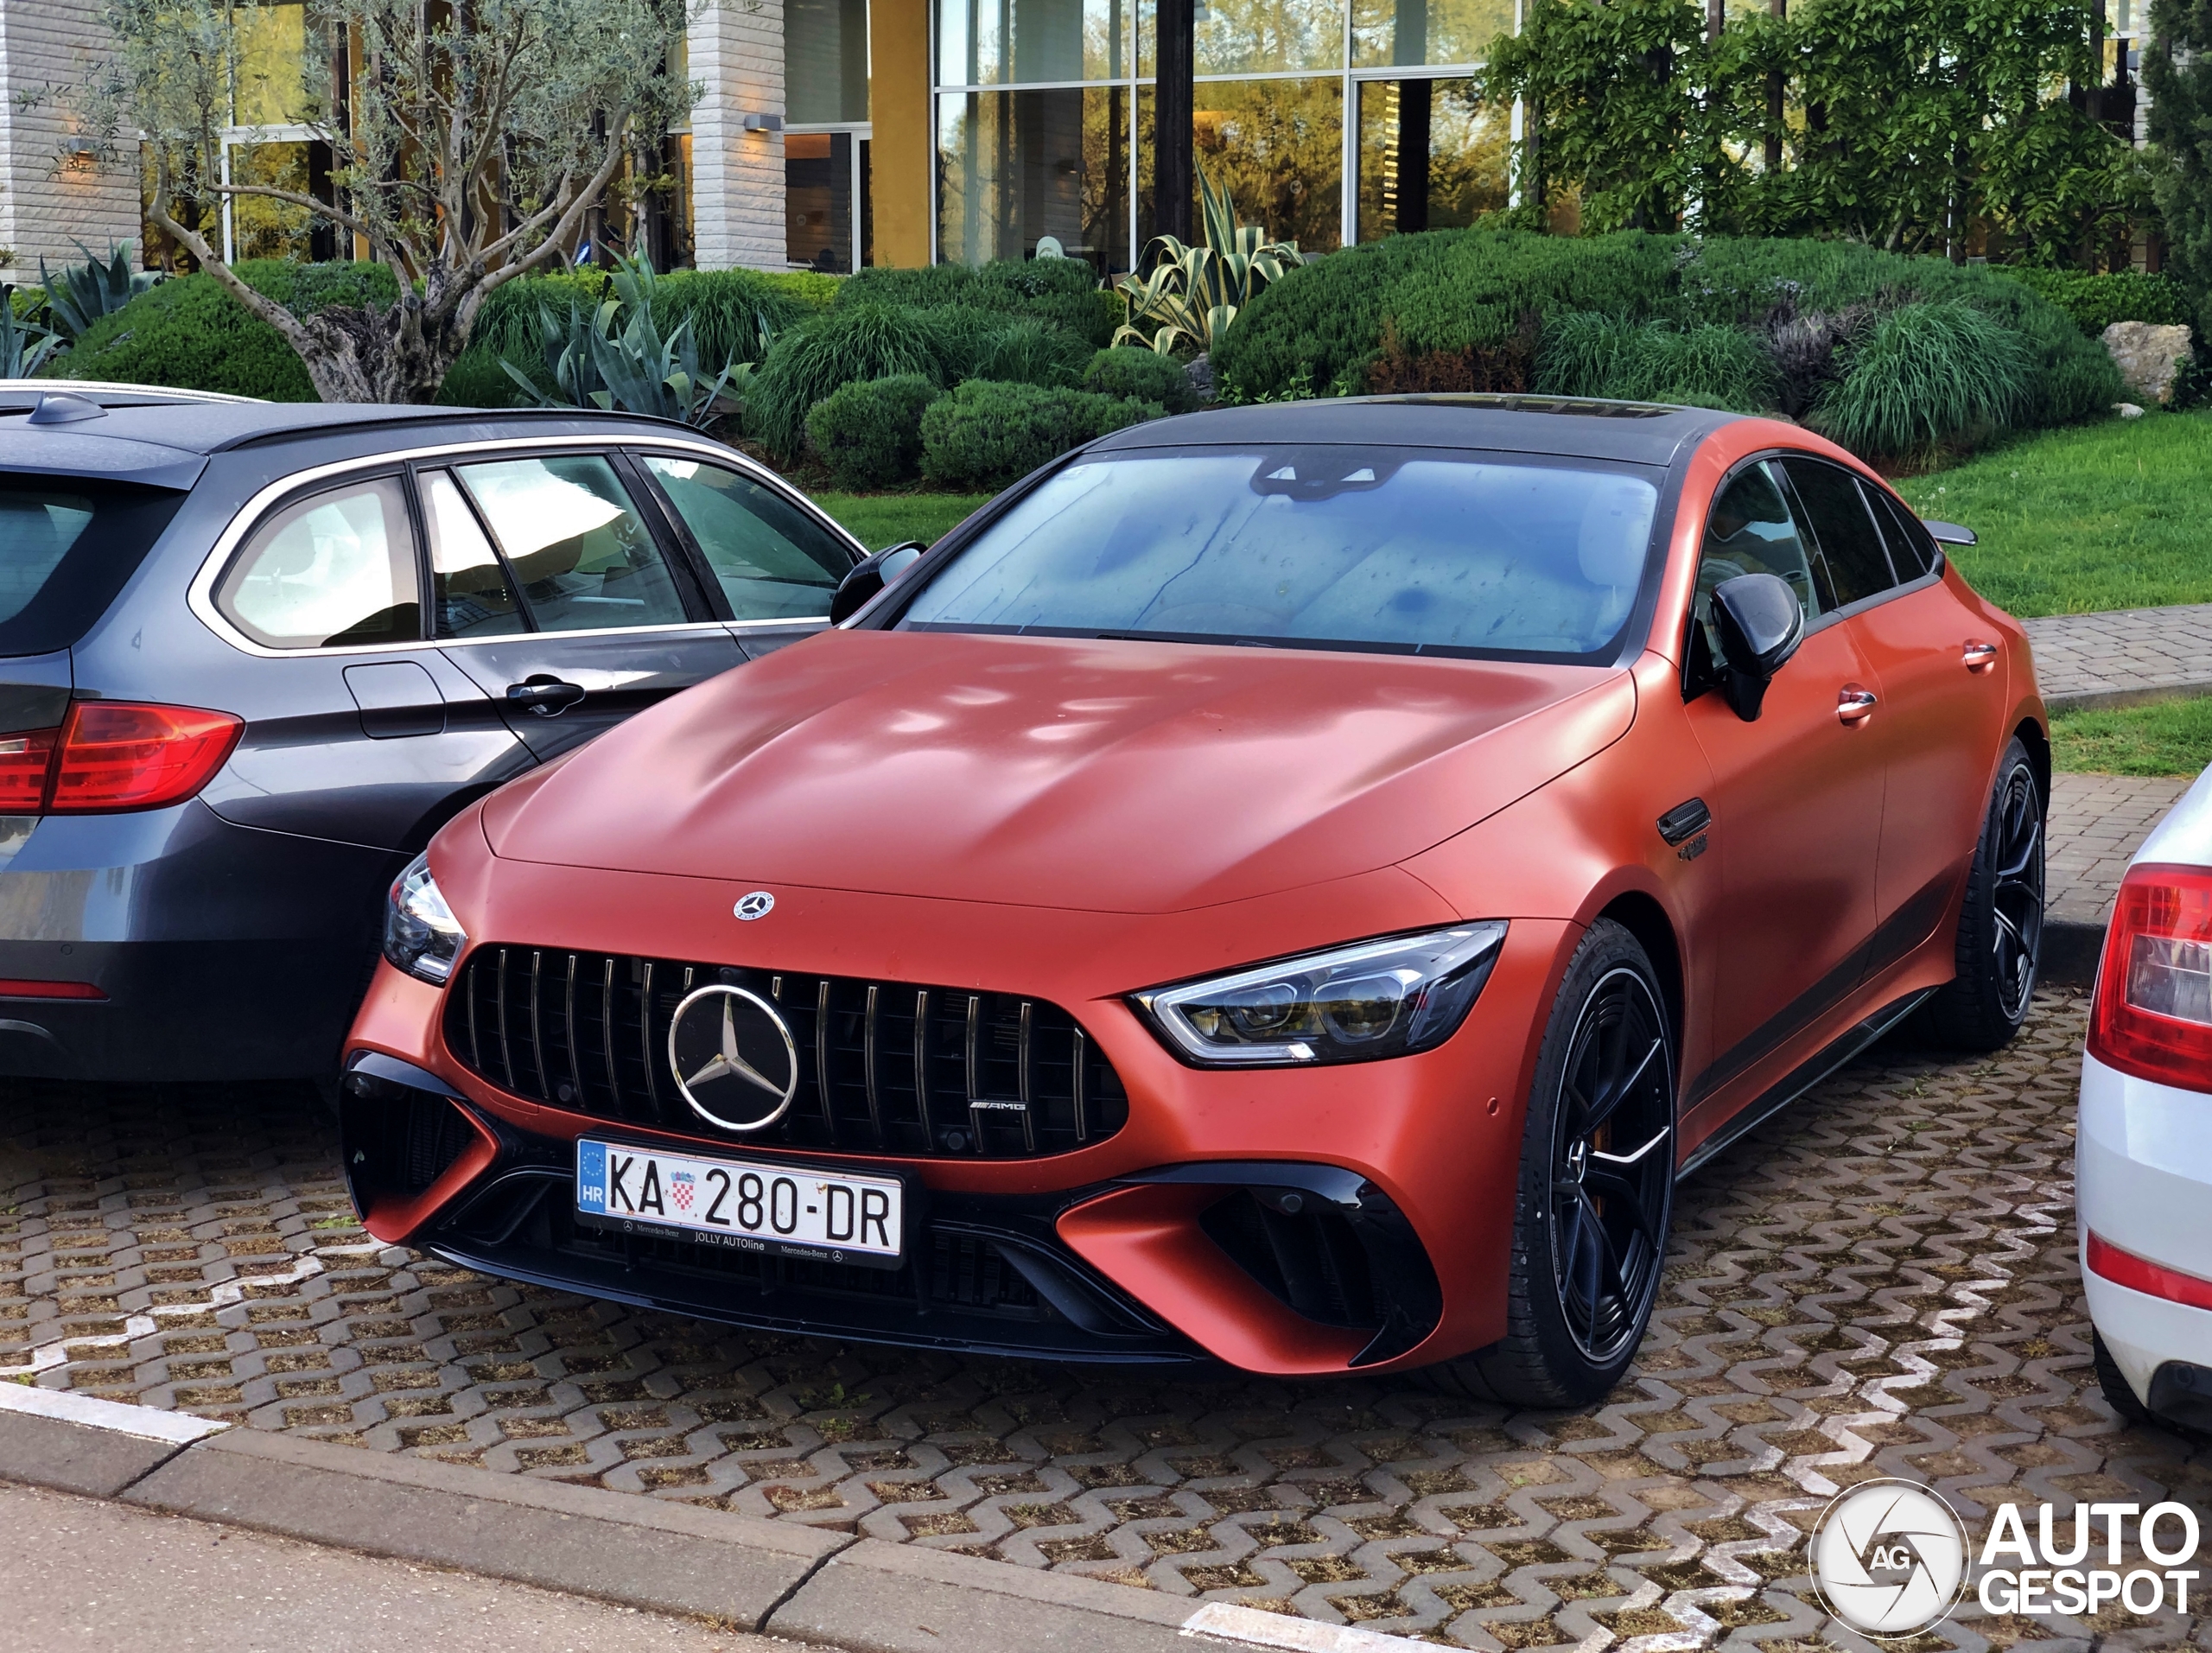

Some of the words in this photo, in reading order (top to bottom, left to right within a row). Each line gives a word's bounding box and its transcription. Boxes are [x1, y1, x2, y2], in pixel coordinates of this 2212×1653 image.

[583, 1185, 603, 1204] HR
[610, 1154, 664, 1216] KA
[705, 1168, 890, 1246] 280-DR
[638, 1224, 679, 1237] Mercedes-Benz
[695, 1231, 721, 1244] JOLLY
[723, 1236, 765, 1251] AUTOline
[780, 1245, 828, 1259] Mercedes-Benz
